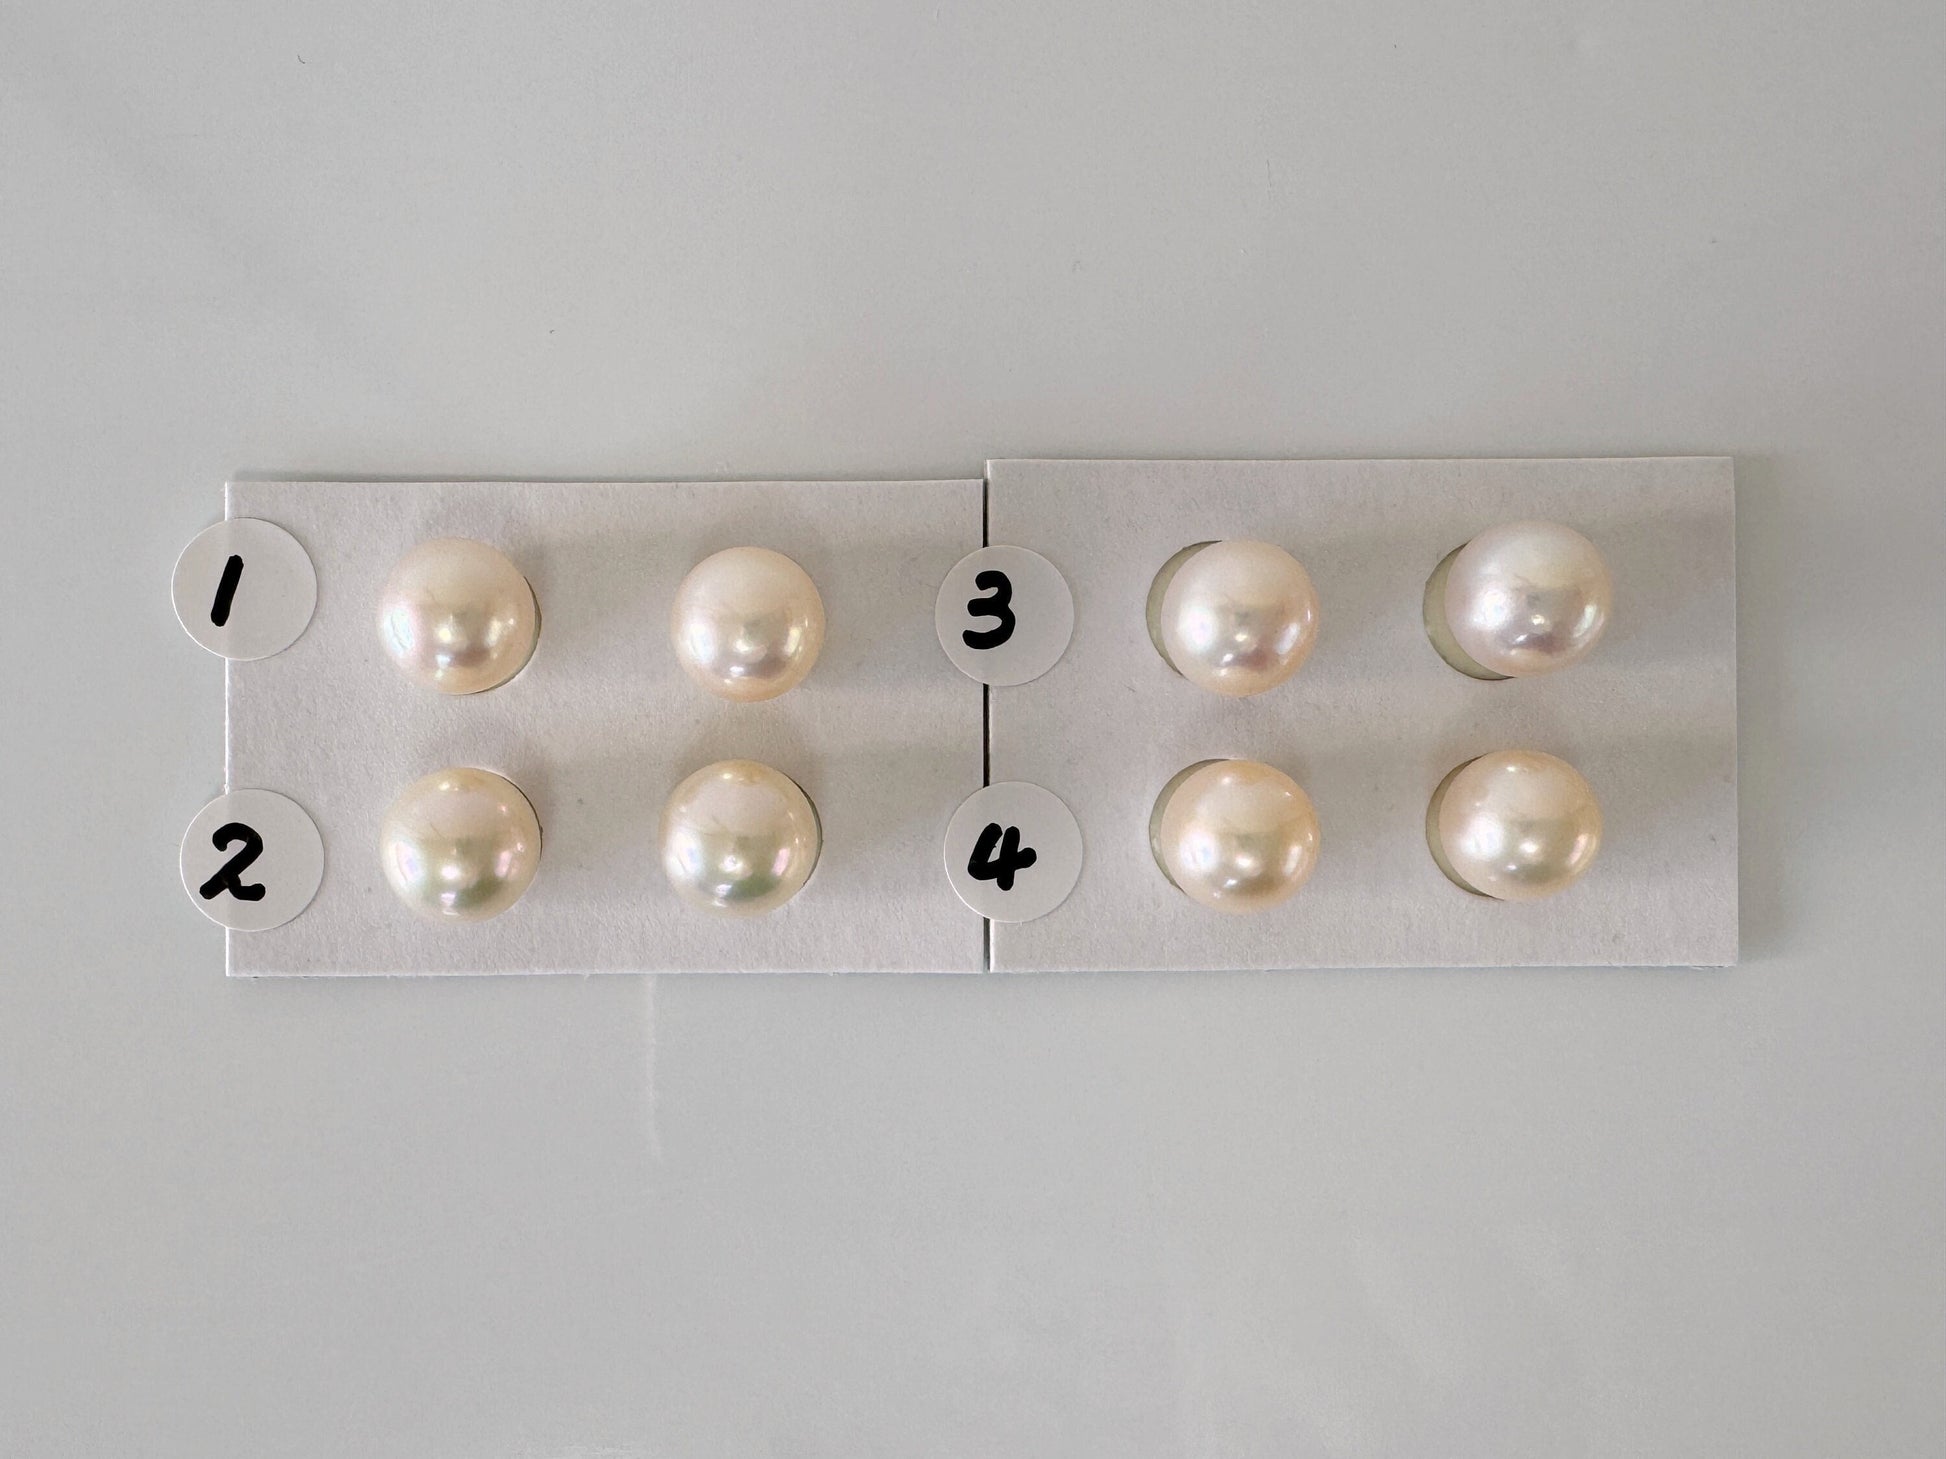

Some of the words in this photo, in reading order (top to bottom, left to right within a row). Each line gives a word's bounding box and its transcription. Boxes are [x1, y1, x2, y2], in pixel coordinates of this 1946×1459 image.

[211, 555, 244, 626] 1
[963, 571, 1015, 649] 3
[200, 823, 265, 901] 2
[968, 823, 1037, 891] 4
